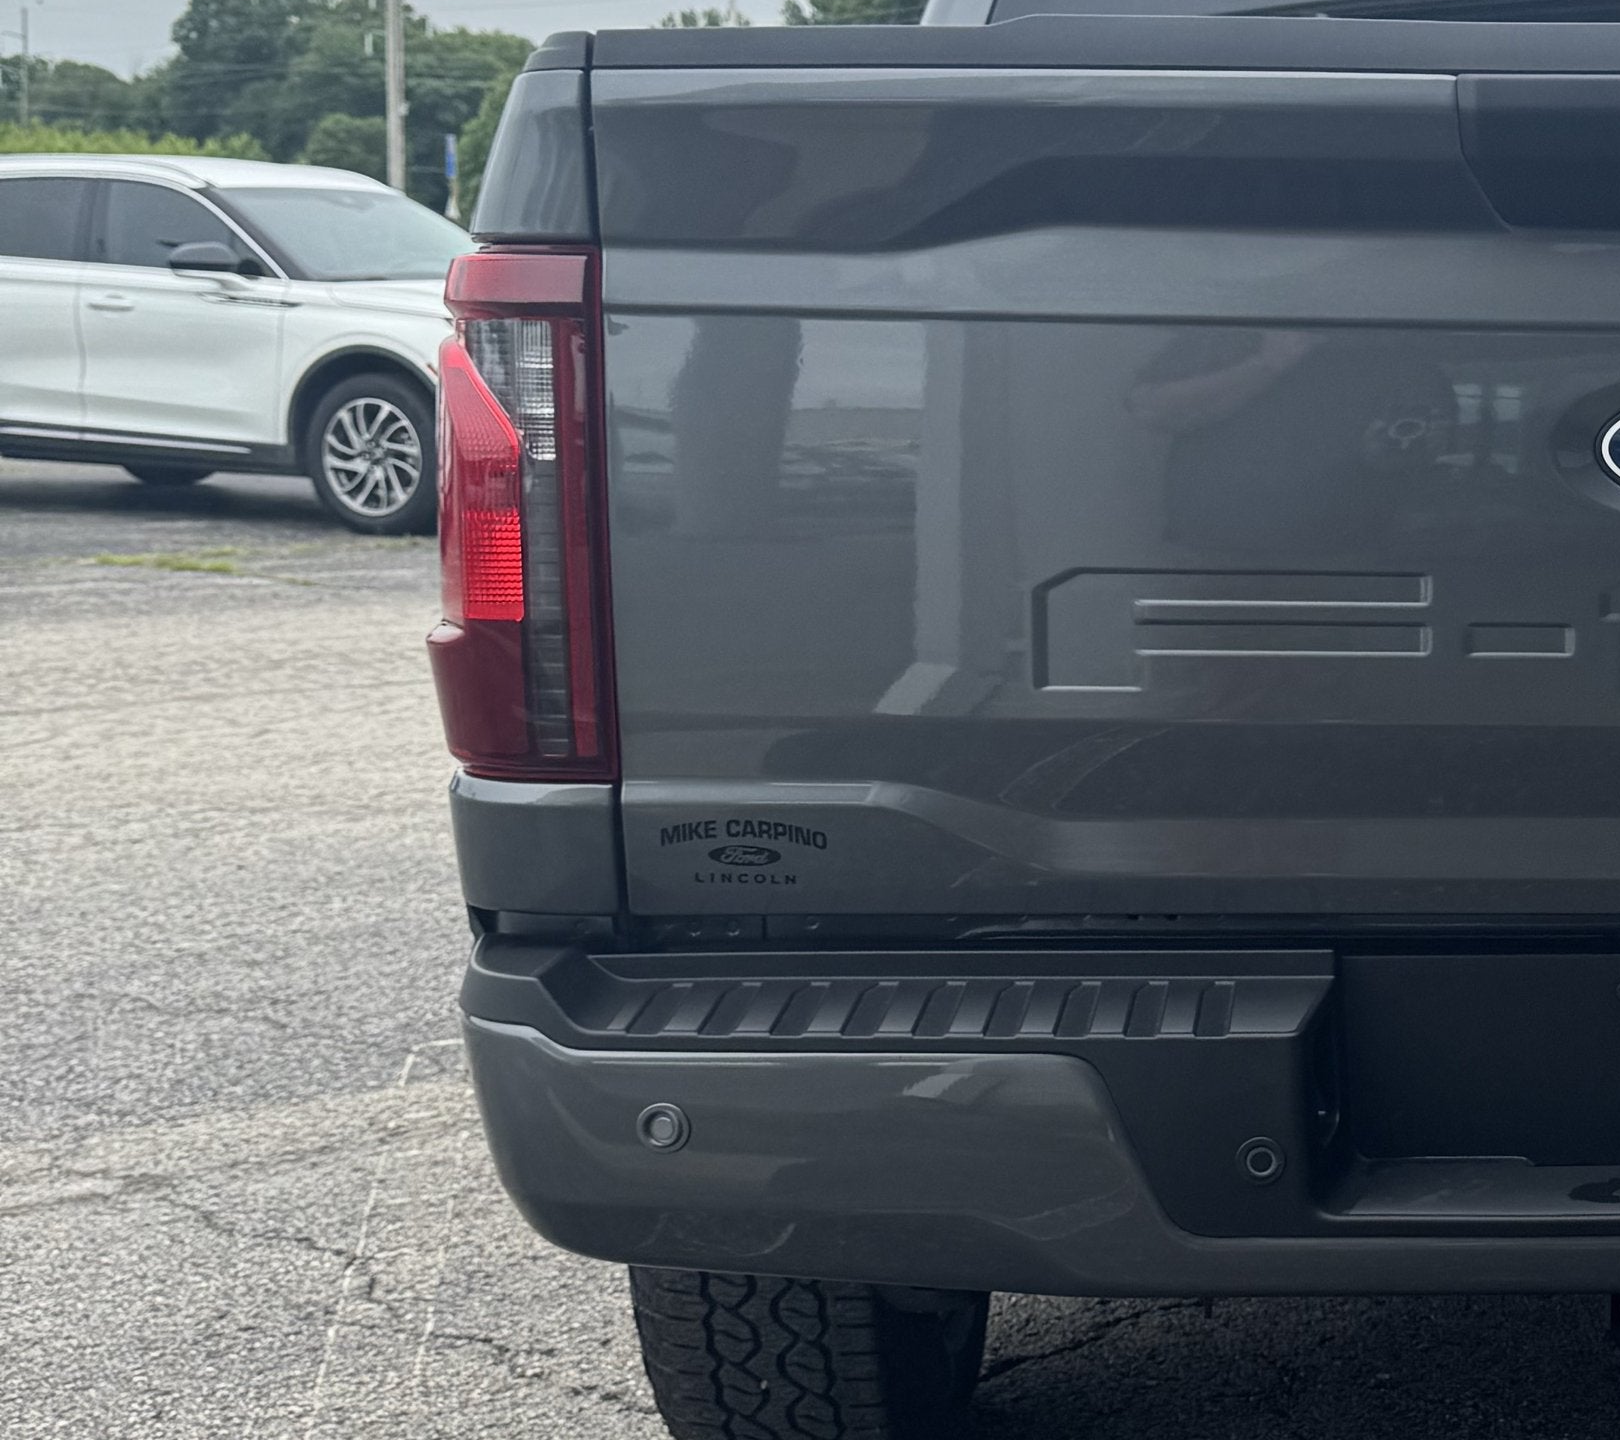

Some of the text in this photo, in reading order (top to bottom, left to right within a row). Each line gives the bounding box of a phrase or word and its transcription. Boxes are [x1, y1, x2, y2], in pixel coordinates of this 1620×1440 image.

[659, 818, 828, 851] MIKE CARPINO
[719, 846, 770, 864] Ford
[694, 871, 798, 885] LINCOLN
